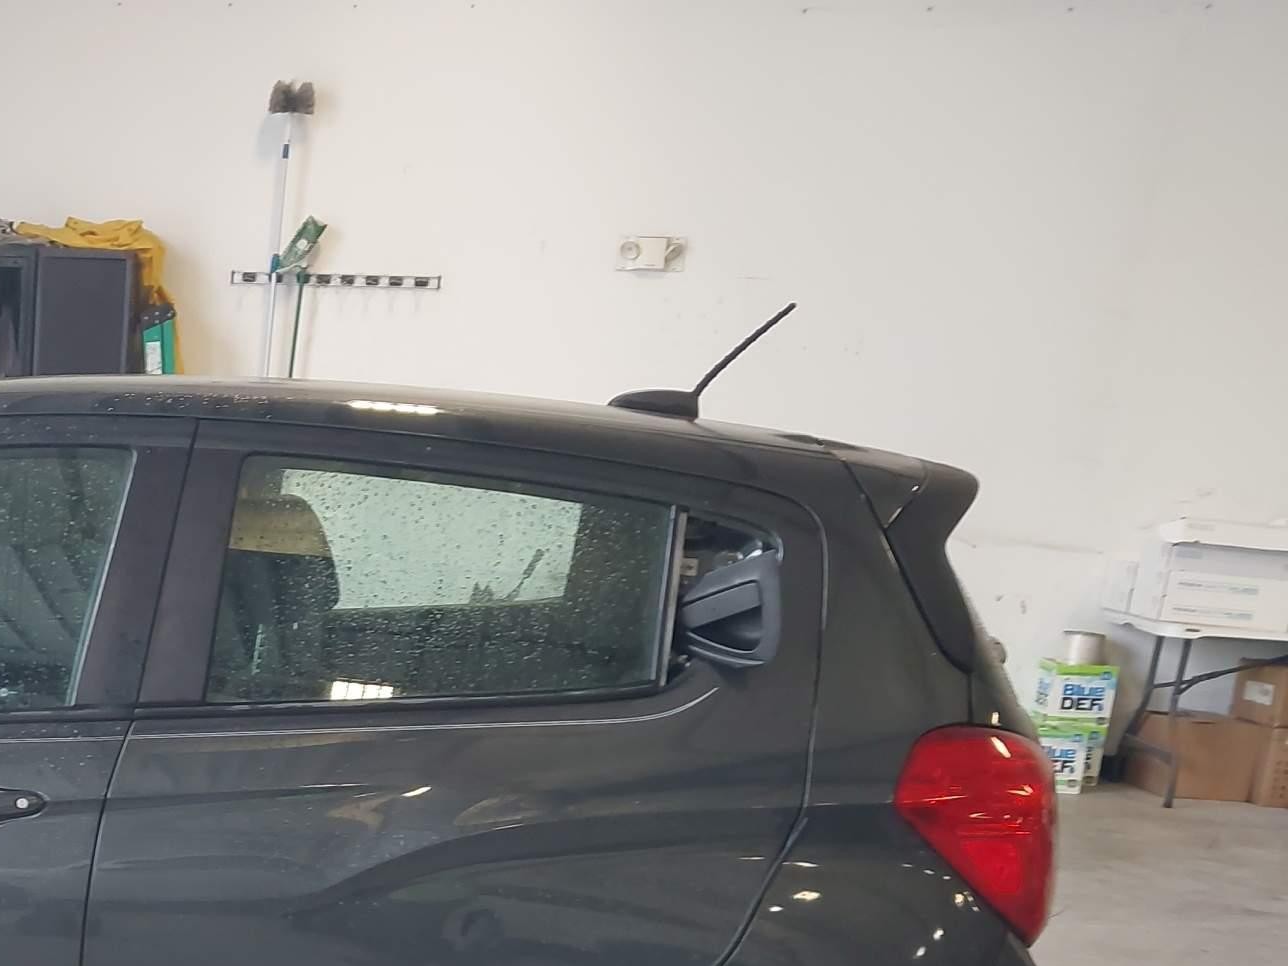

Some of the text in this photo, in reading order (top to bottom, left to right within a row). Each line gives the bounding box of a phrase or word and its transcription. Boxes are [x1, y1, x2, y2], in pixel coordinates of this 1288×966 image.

[1063, 683, 1105, 697] Blue
[1061, 696, 1104, 711] DEF
[1052, 759, 1075, 774] EF
